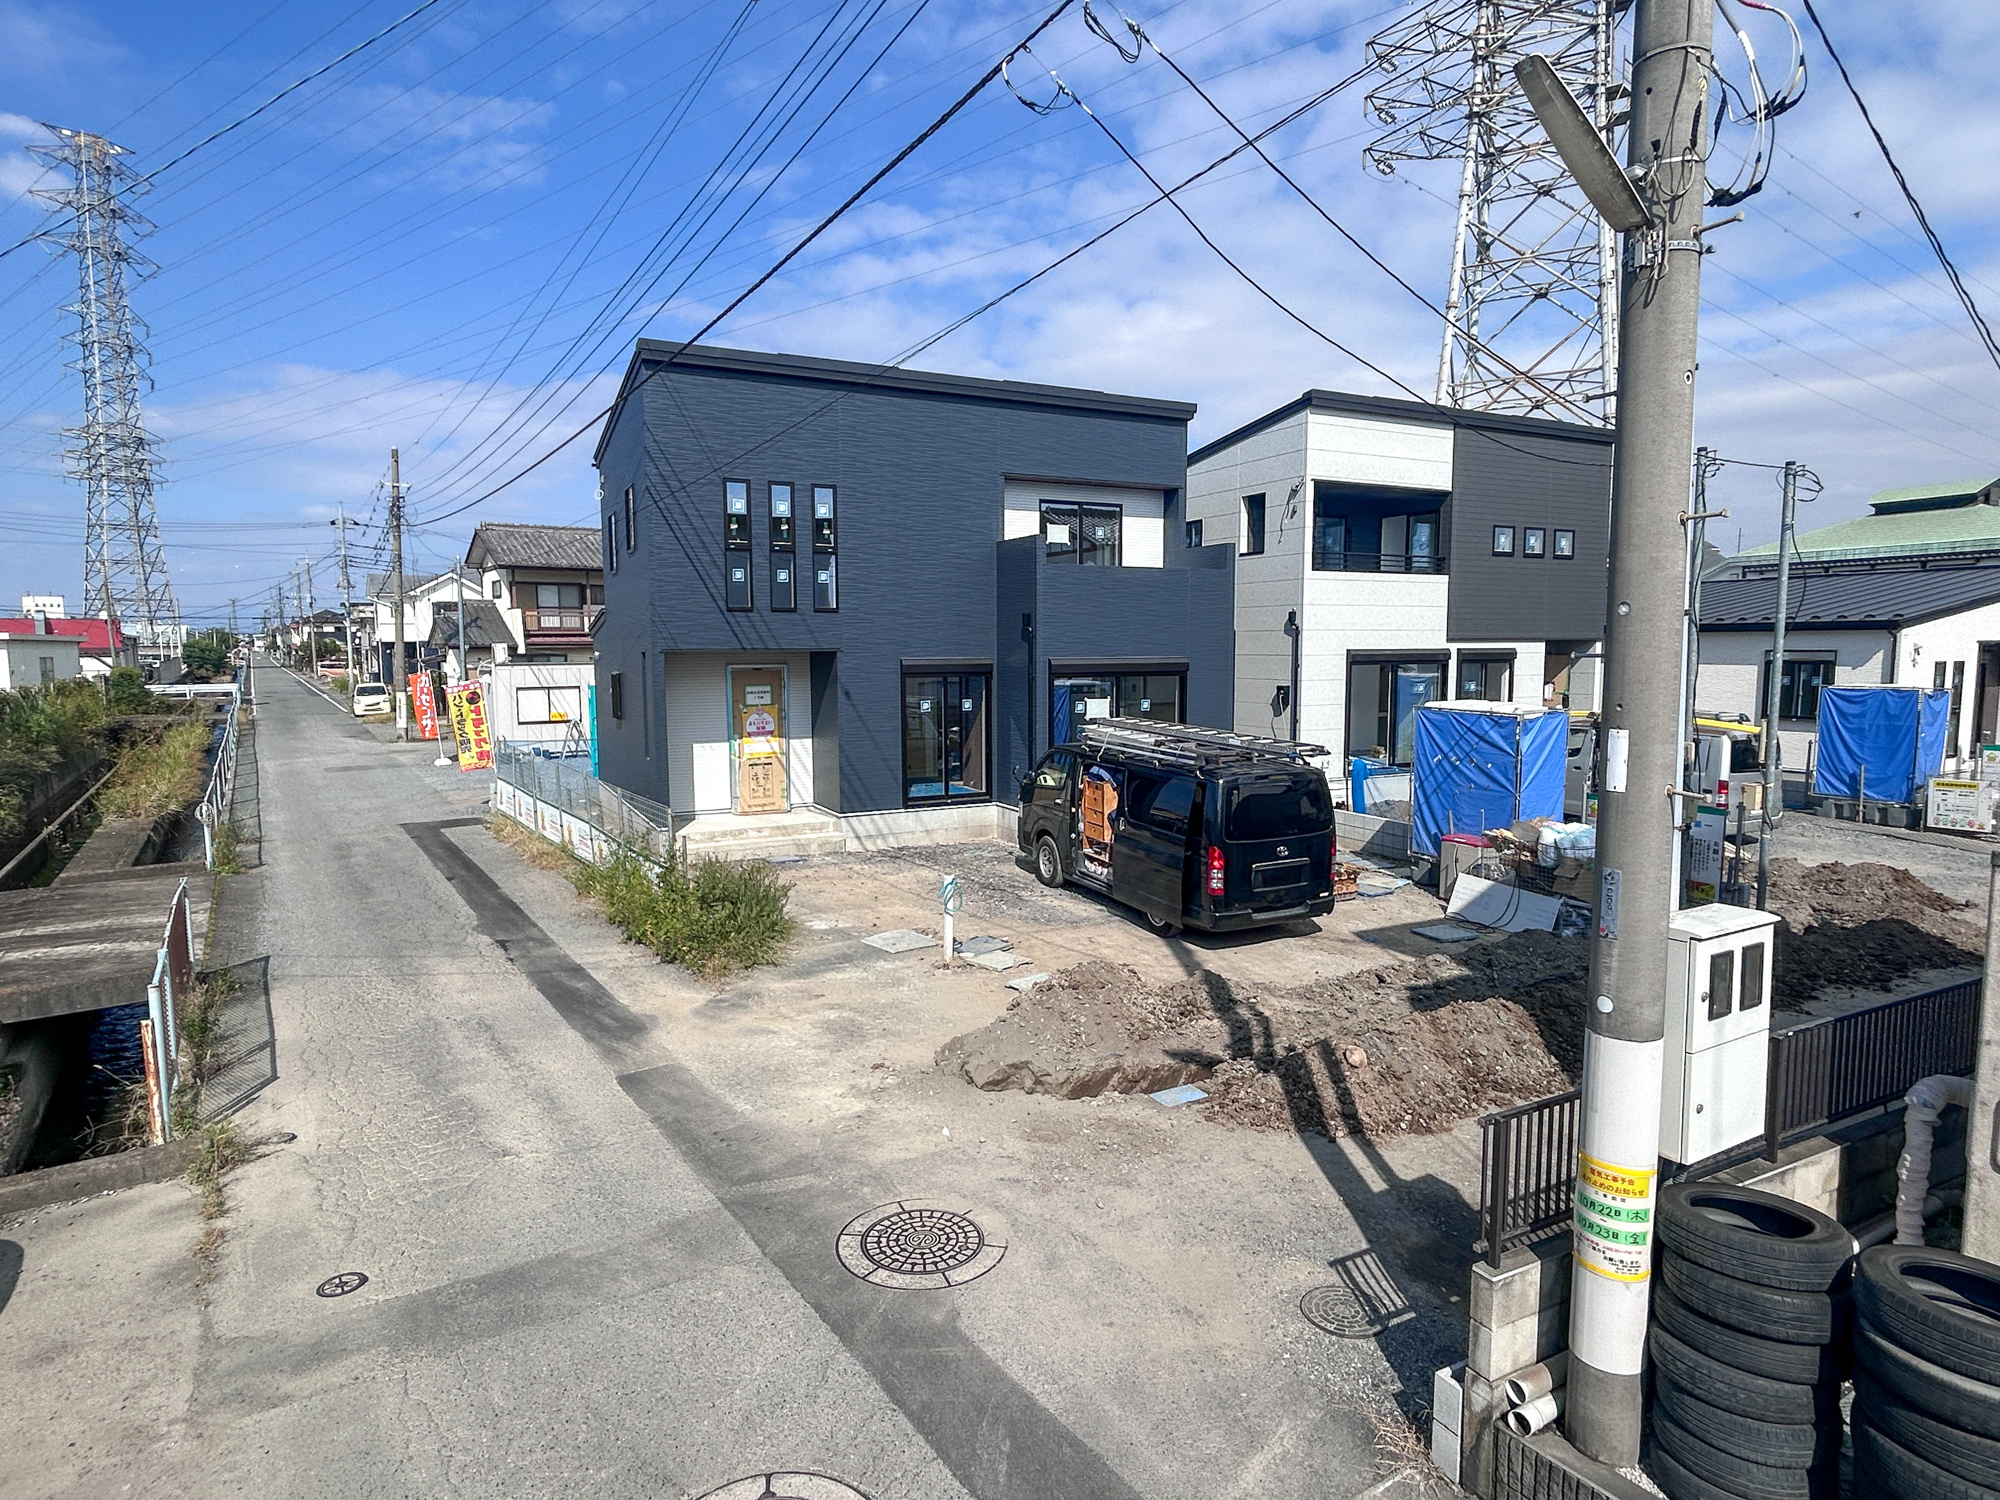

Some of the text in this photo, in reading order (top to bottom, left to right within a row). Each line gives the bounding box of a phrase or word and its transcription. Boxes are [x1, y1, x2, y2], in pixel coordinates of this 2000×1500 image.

[420, 674, 434, 738] カーセンサー
[1589, 1166, 1635, 1186] 電気工事予告
